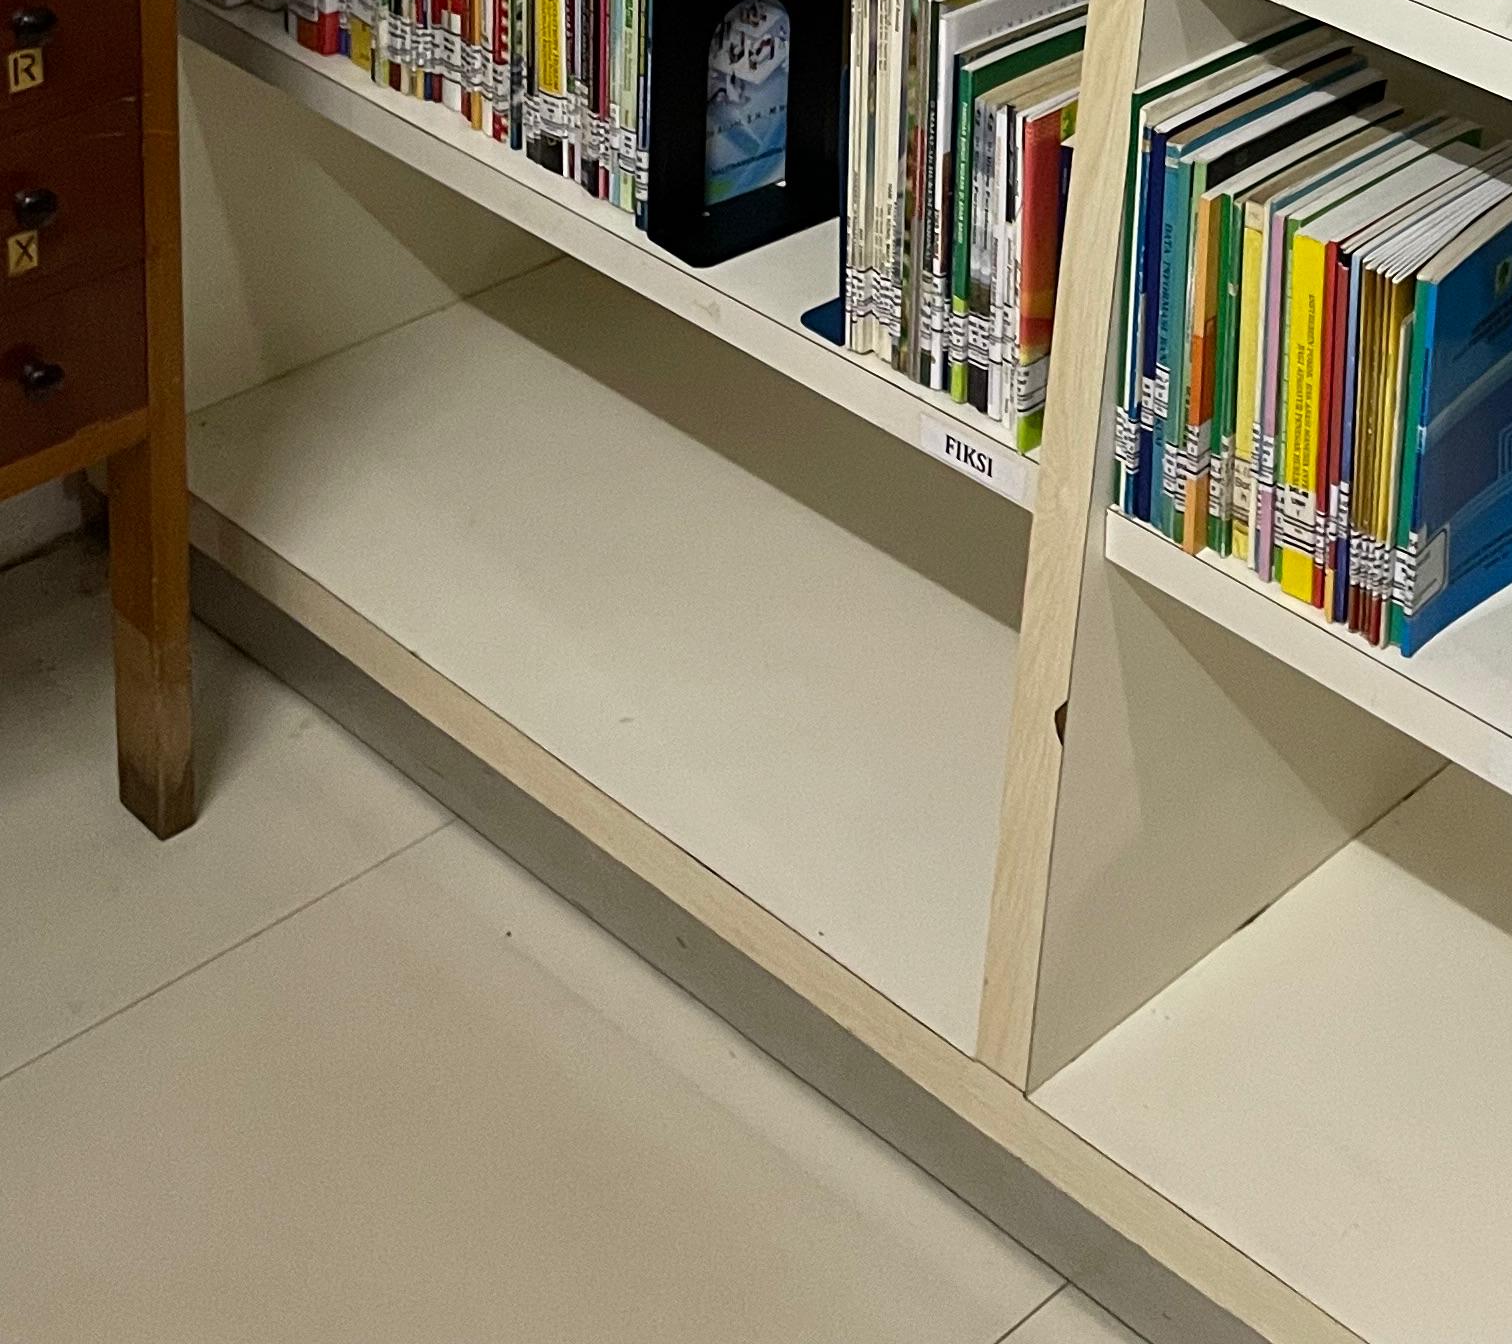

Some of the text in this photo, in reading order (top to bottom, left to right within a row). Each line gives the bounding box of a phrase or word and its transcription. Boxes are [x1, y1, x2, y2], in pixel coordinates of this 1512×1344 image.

[15, 51, 41, 89] R
[14, 233, 38, 265] X
[944, 434, 993, 469] FIKSI
